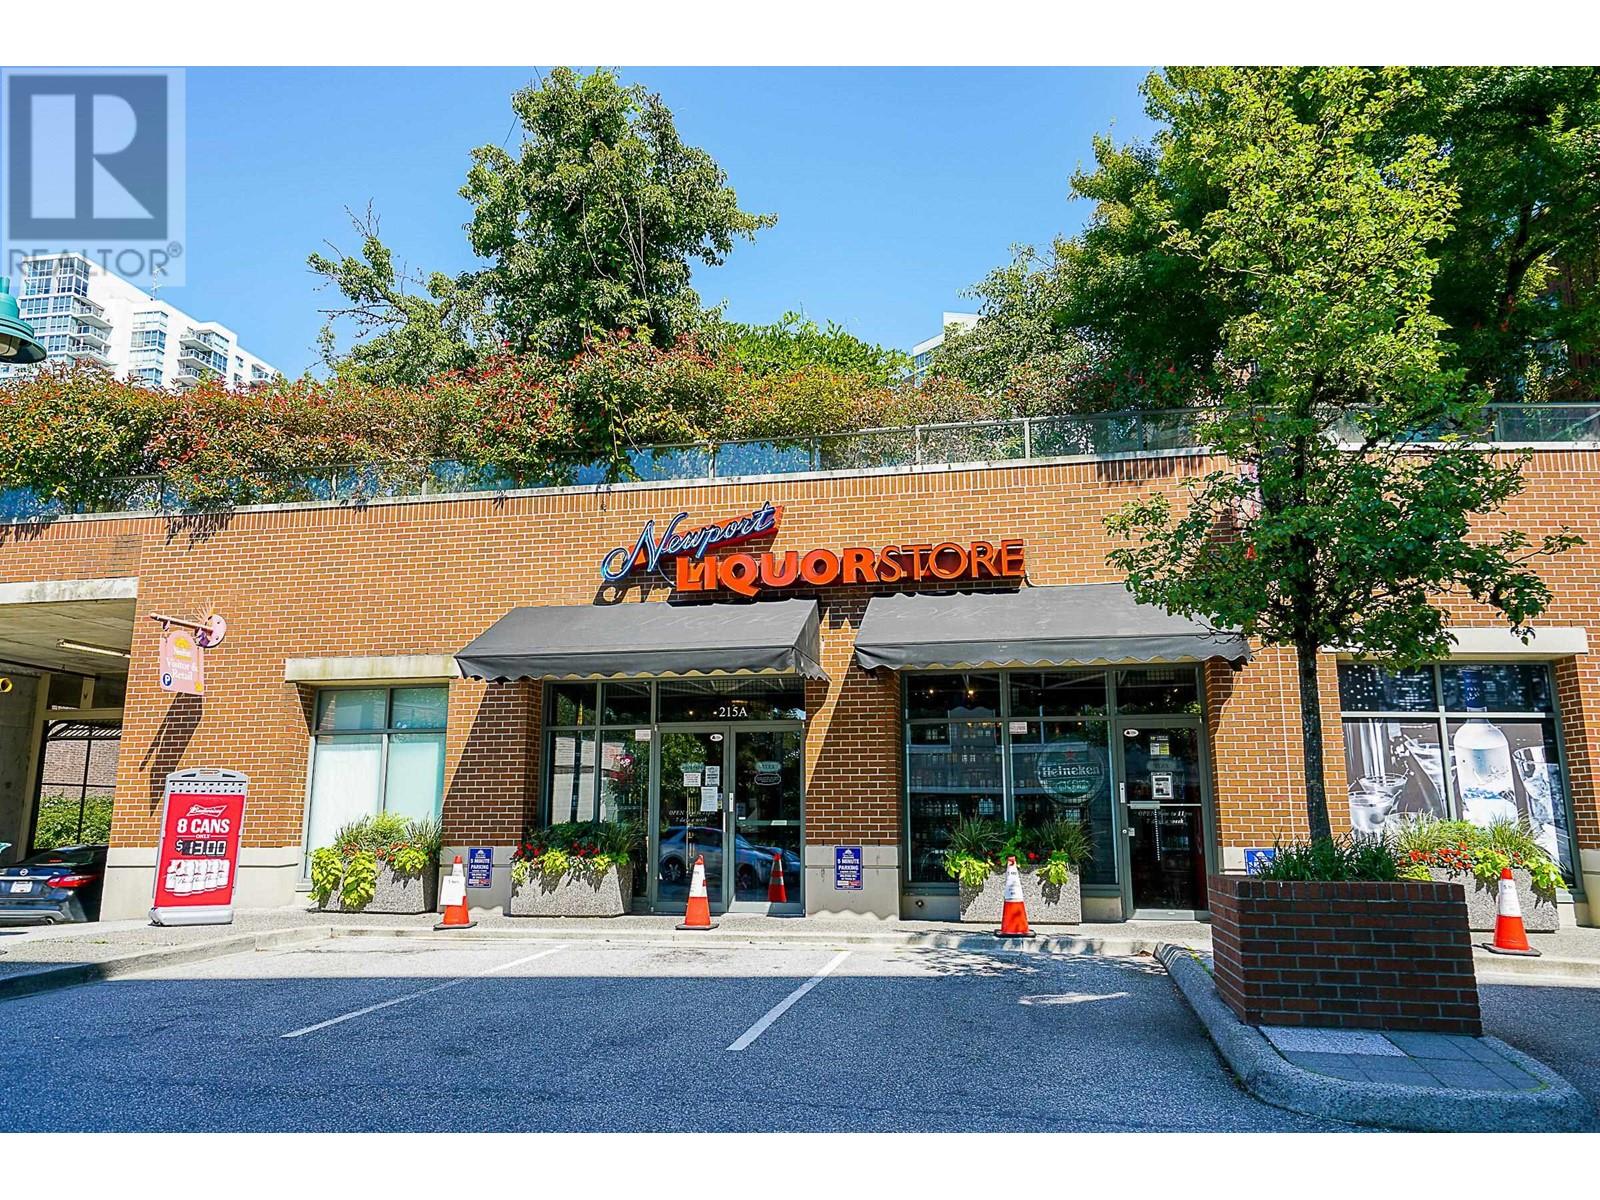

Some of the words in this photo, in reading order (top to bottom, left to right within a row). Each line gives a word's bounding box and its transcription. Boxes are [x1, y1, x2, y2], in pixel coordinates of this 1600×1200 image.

[601, 501, 776, 581] Newport
[676, 548, 880, 597] LIQUOR
[880, 539, 1025, 583] STORE
[719, 706, 748, 718] 215A
[1041, 765, 1100, 778] Heineken
[177, 818, 188, 834] 8
[190, 818, 231, 834] CANS
